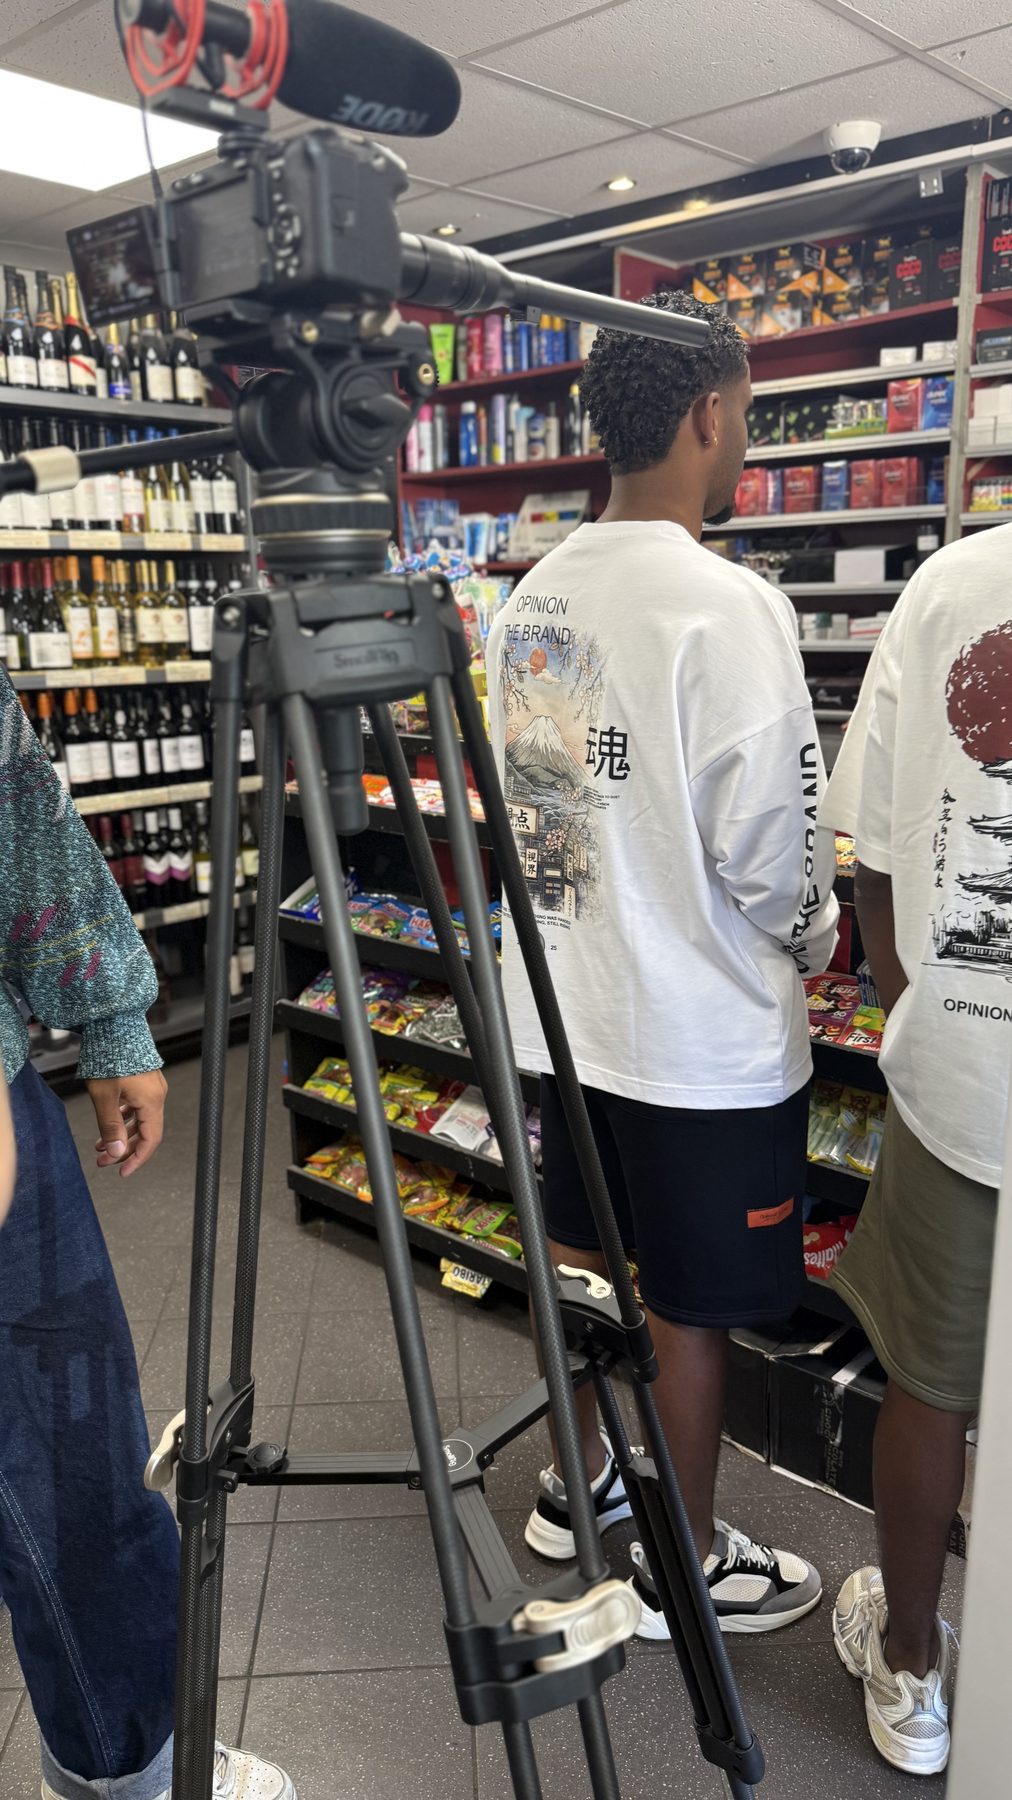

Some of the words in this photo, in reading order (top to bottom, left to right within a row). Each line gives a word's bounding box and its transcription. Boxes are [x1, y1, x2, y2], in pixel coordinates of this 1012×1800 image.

[516, 595, 569, 615] OPINION
[504, 624, 520, 641] THE
[521, 624, 571, 645] BRAND
[585, 726, 631, 780] 魂
